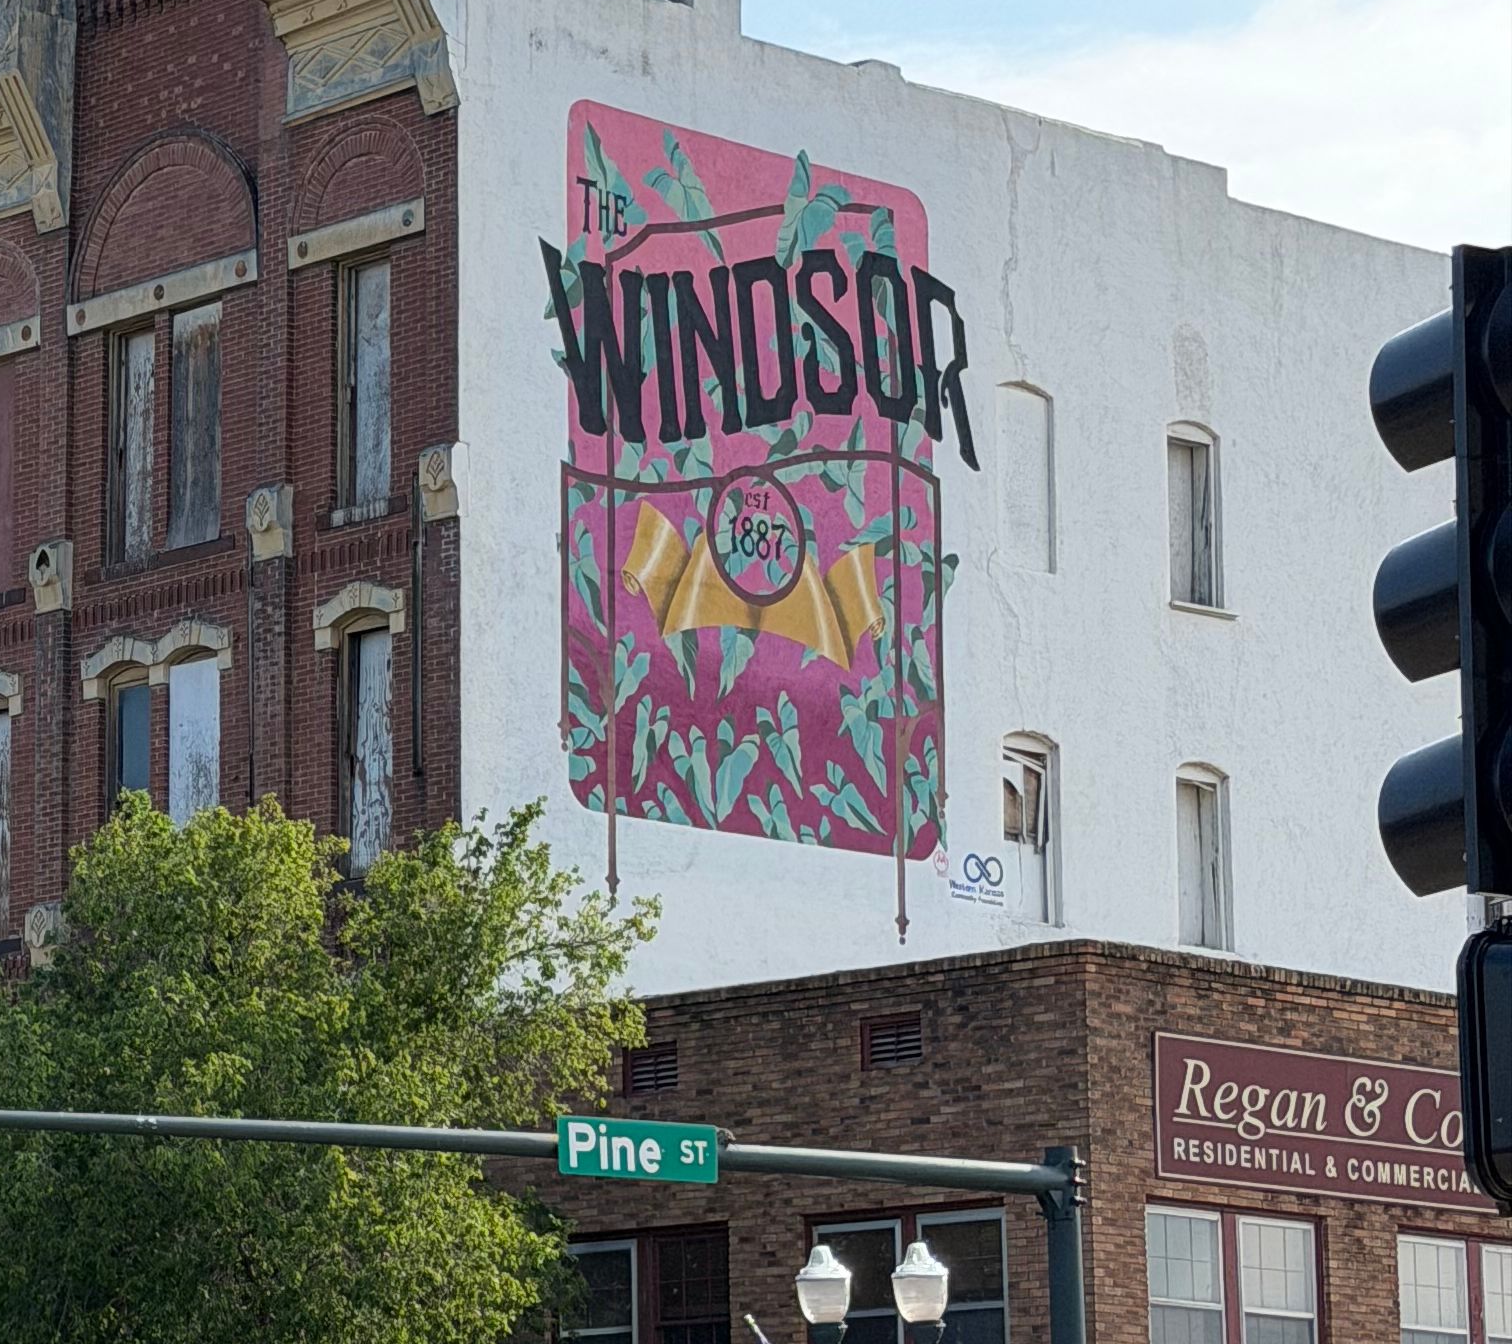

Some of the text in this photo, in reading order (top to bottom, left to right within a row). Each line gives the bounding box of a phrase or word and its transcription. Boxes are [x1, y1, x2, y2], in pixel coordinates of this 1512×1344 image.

[576, 176, 633, 243] THE
[538, 235, 980, 472] WINDSOR
[745, 492, 770, 511] est
[729, 516, 785, 561] 1887
[1173, 1058, 1327, 1140] Regan
[1345, 1076, 1389, 1137] &
[567, 1121, 708, 1174] Pine ST
[1173, 1137, 1316, 1176] RESIDENTIAL
[1325, 1155, 1338, 1179] &
